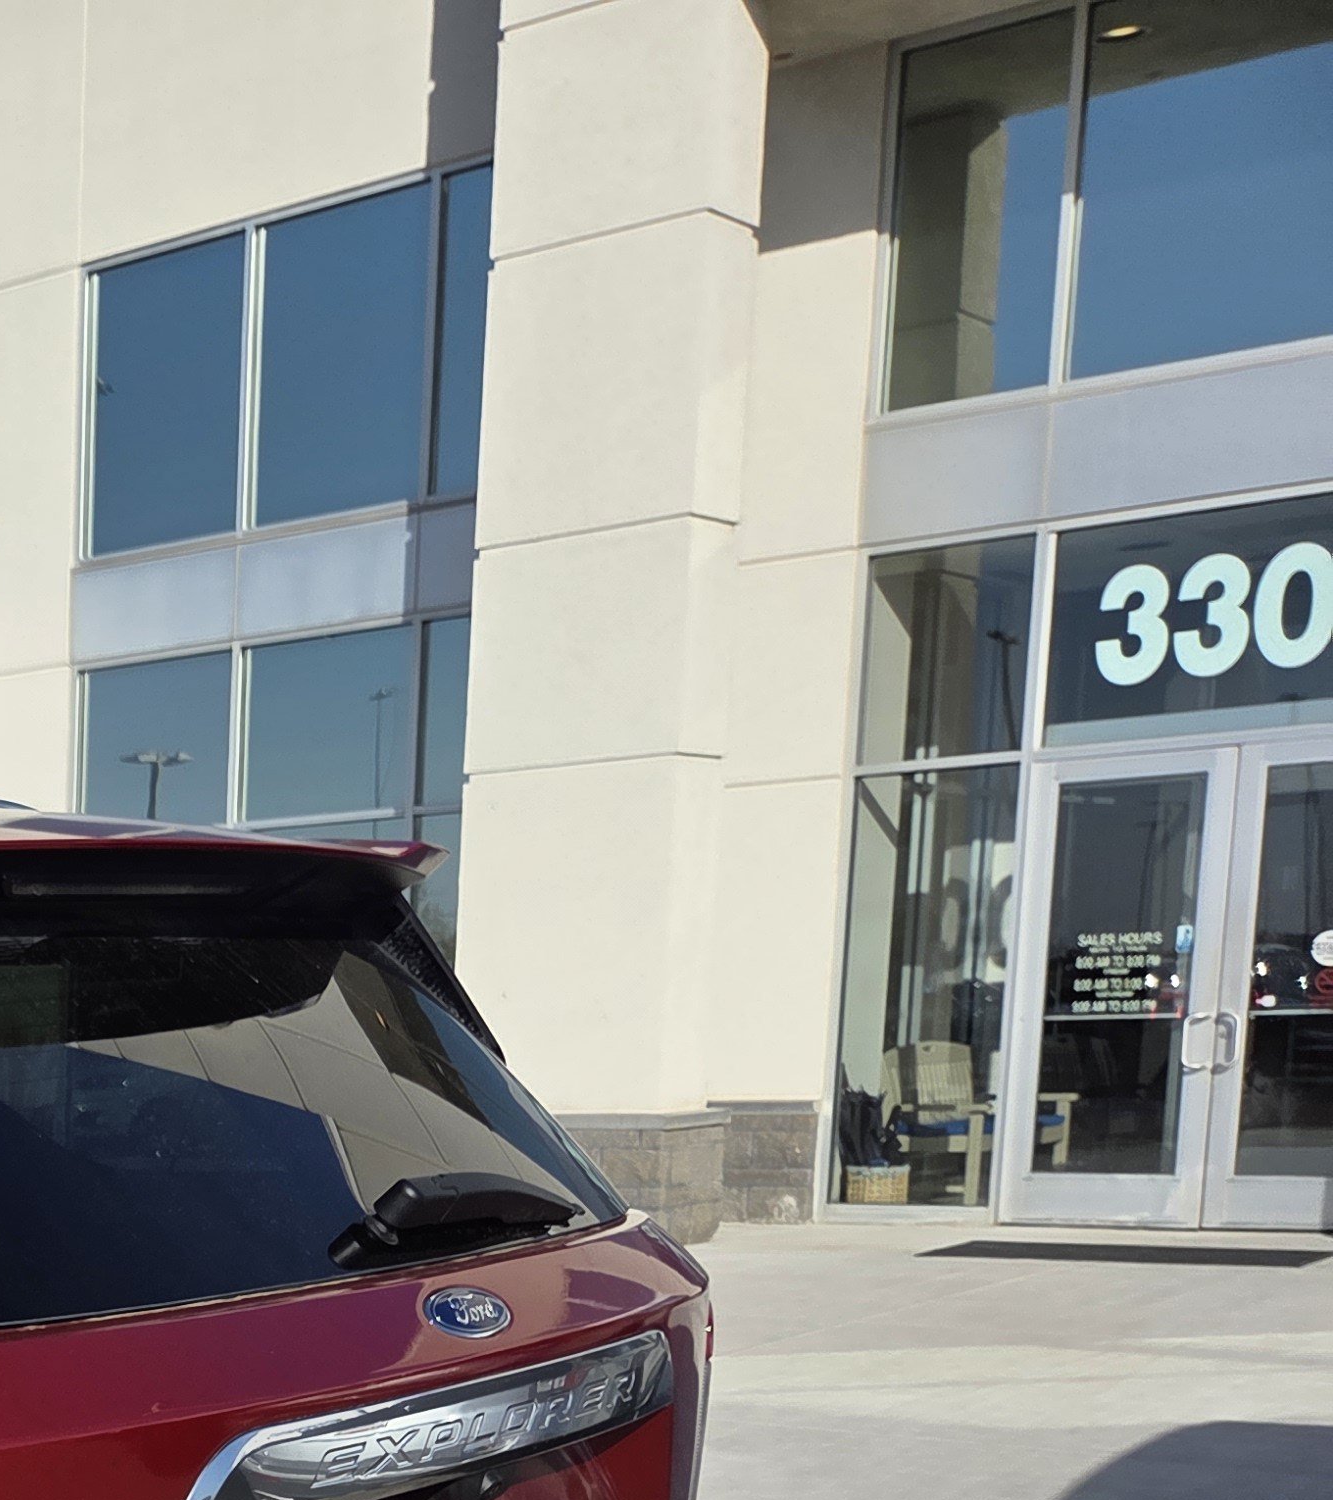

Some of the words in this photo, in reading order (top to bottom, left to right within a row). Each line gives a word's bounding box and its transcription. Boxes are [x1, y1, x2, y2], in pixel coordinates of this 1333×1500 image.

[1095, 542, 1333, 686] 330
[1077, 934, 1115, 946] SALES
[1119, 932, 1162, 944] HOURS
[447, 1292, 499, 1325] Ford
[310, 1368, 637, 1489] EXPLORER
